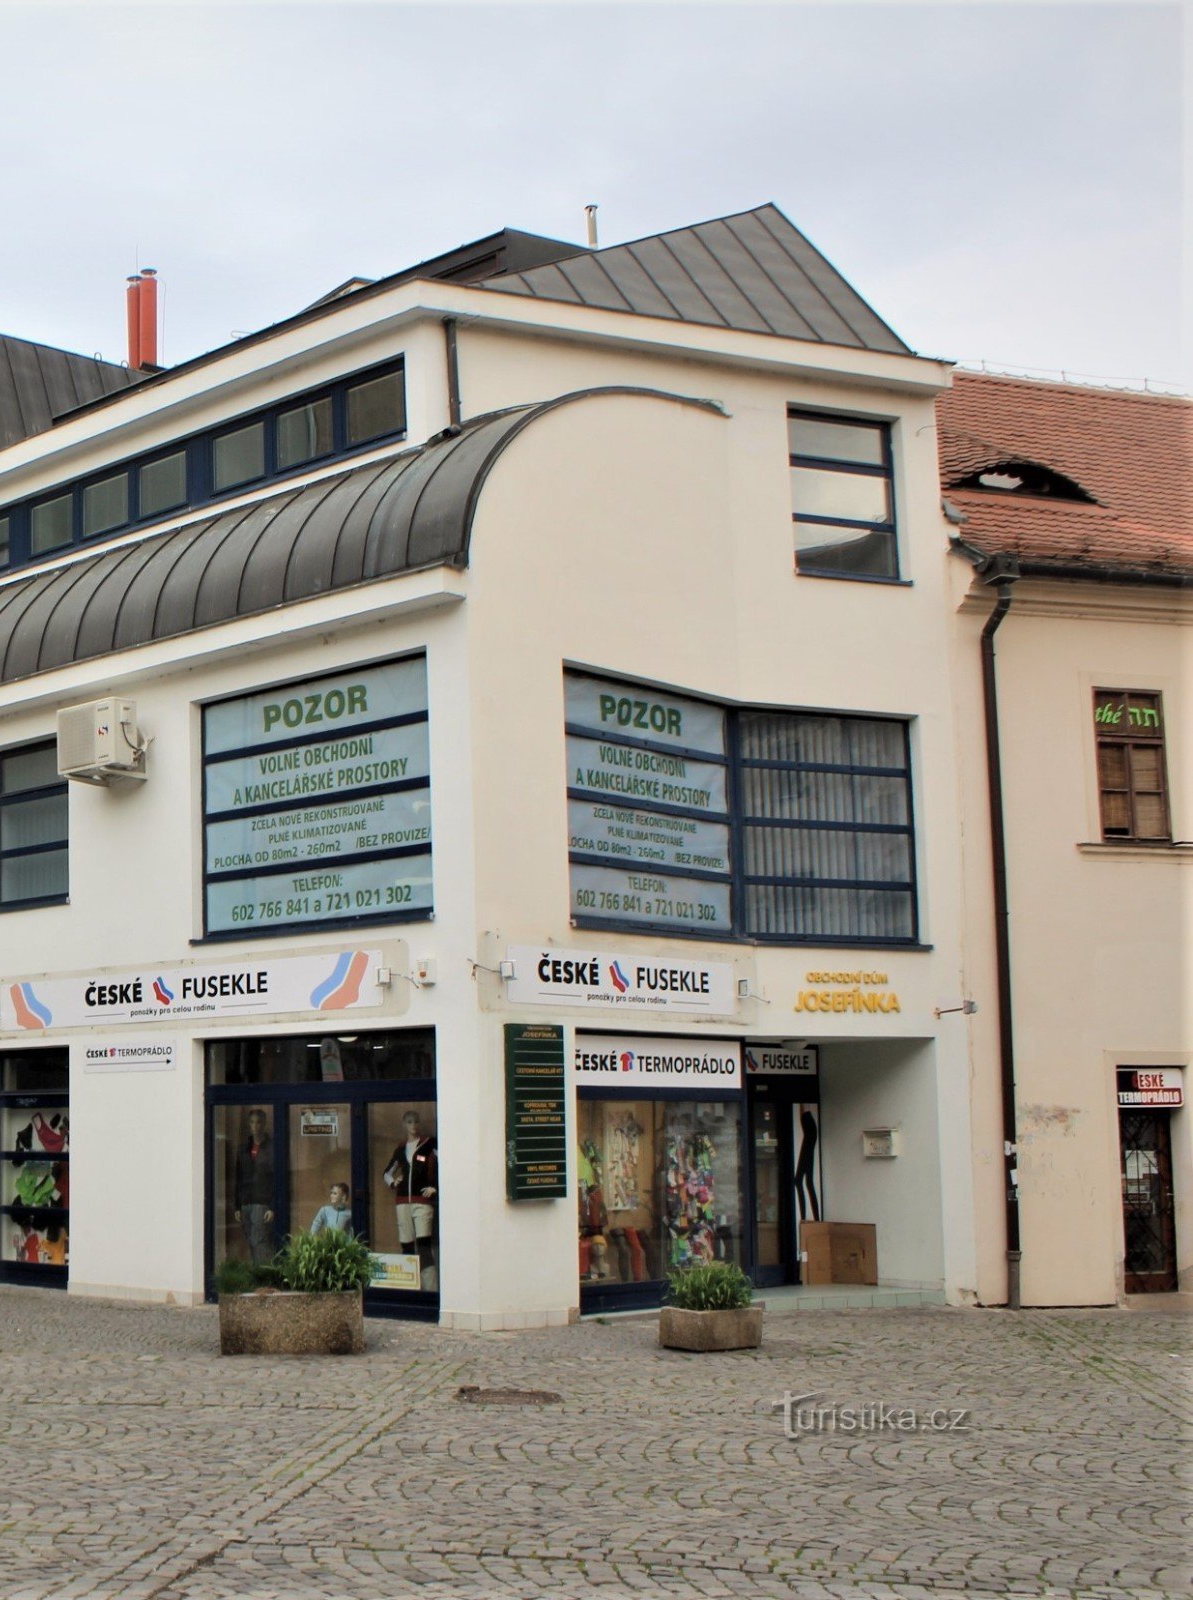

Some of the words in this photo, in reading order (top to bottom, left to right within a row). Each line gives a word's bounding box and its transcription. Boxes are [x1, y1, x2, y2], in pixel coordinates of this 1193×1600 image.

[263, 685, 368, 733] POZOR
[599, 694, 682, 736] POZOR
[1095, 703, 1125, 724] thé
[259, 749, 300, 775] VOLNÉ
[304, 734, 373, 767] OBCHODNÍ
[599, 745, 632, 767] VOLNÉ
[234, 788, 242, 805] A
[245, 767, 333, 803] KANCELÁŘSKÉ
[338, 757, 409, 786] PROSTORY
[576, 768, 584, 785] A
[662, 782, 711, 807] PROSTORY
[251, 819, 277, 831] ZCELA
[303, 800, 385, 823] REKONSTRUOVANÉ
[593, 807, 615, 820] ZCELA
[292, 819, 367, 841] KLIMATIZOVANÉ
[214, 855, 252, 868] PLOCHA
[255, 851, 269, 863] OD
[272, 846, 298, 861] 80m2
[307, 840, 341, 855] 260m2
[356, 834, 378, 849] /BEZ
[597, 840, 609, 852] OD
[611, 842, 632, 856] 80m2
[638, 847, 666, 860] 260m2
[292, 874, 343, 893] TELEFON:
[628, 876, 667, 893] TELEFON:
[232, 904, 254, 922] 602
[259, 901, 282, 919] 766
[286, 897, 309, 915] 841
[314, 899, 321, 912] a
[326, 893, 350, 911] 721
[357, 888, 381, 907] 021
[386, 885, 412, 904] 302
[576, 889, 596, 907] 602
[600, 892, 620, 910] 766
[623, 894, 641, 912] 841
[645, 901, 651, 914] a
[655, 898, 673, 915] 721
[676, 901, 694, 919] 021
[698, 903, 716, 921] 302
[538, 953, 599, 986] ČESKÉ
[636, 966, 710, 993] FUSEKLE
[85, 977, 143, 1007] ČESKÉ
[182, 971, 268, 999] FUSEKLE
[587, 992, 614, 1003] ponožky
[616, 995, 626, 1003] pro
[628, 995, 645, 1003] celou
[647, 996, 667, 1004] rodinu
[794, 986, 901, 1013] JOSEFÍNKA
[130, 1006, 157, 1017] ponožky
[159, 1007, 171, 1016] pro
[173, 1004, 192, 1014] celou
[193, 1003, 216, 1012] rodinu
[86, 1048, 108, 1059] ČESKÉ
[118, 1045, 172, 1057] TERMOPRÁDLO
[762, 1053, 810, 1070] FUSEKLE
[637, 1053, 735, 1075] TERMOPRÁDLO
[1118, 1089, 1180, 1104] TERMOPRÁDLO
